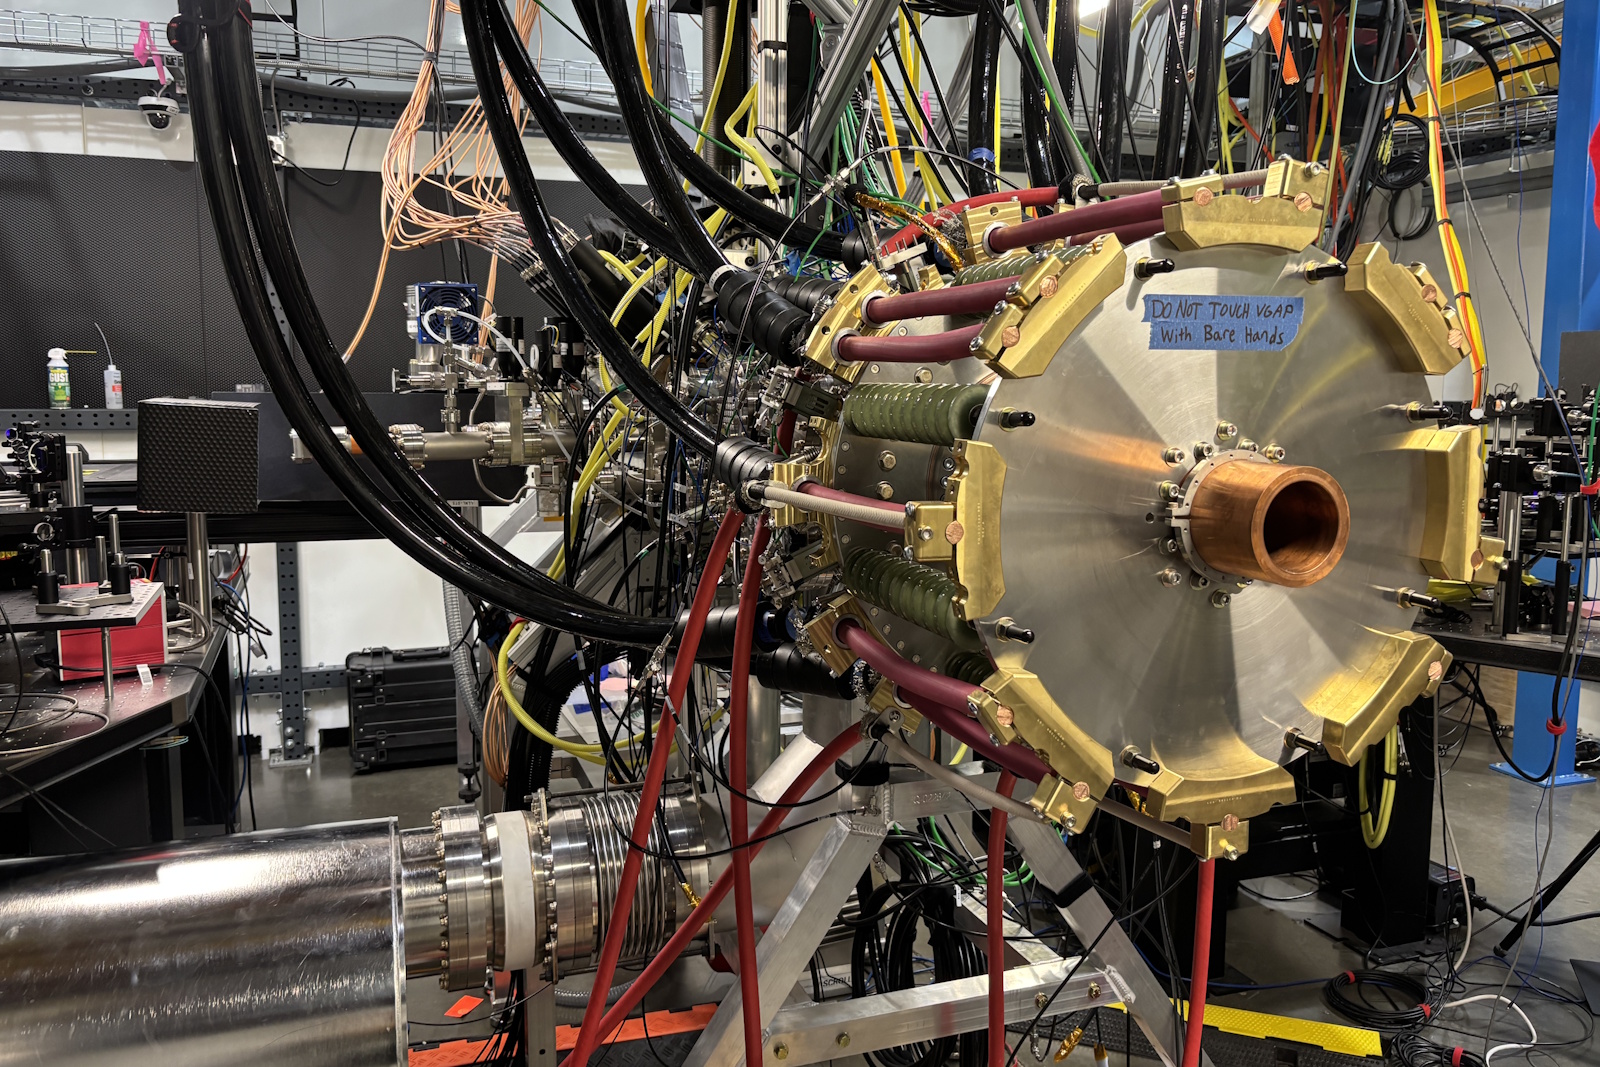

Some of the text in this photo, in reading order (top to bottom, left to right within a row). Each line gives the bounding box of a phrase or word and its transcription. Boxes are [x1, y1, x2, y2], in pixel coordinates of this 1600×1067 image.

[1151, 299, 1294, 320] DO NOT TOUCH VGAP
[1160, 324, 1284, 345] With Bare Hands
[49, 372, 69, 383] GUST
